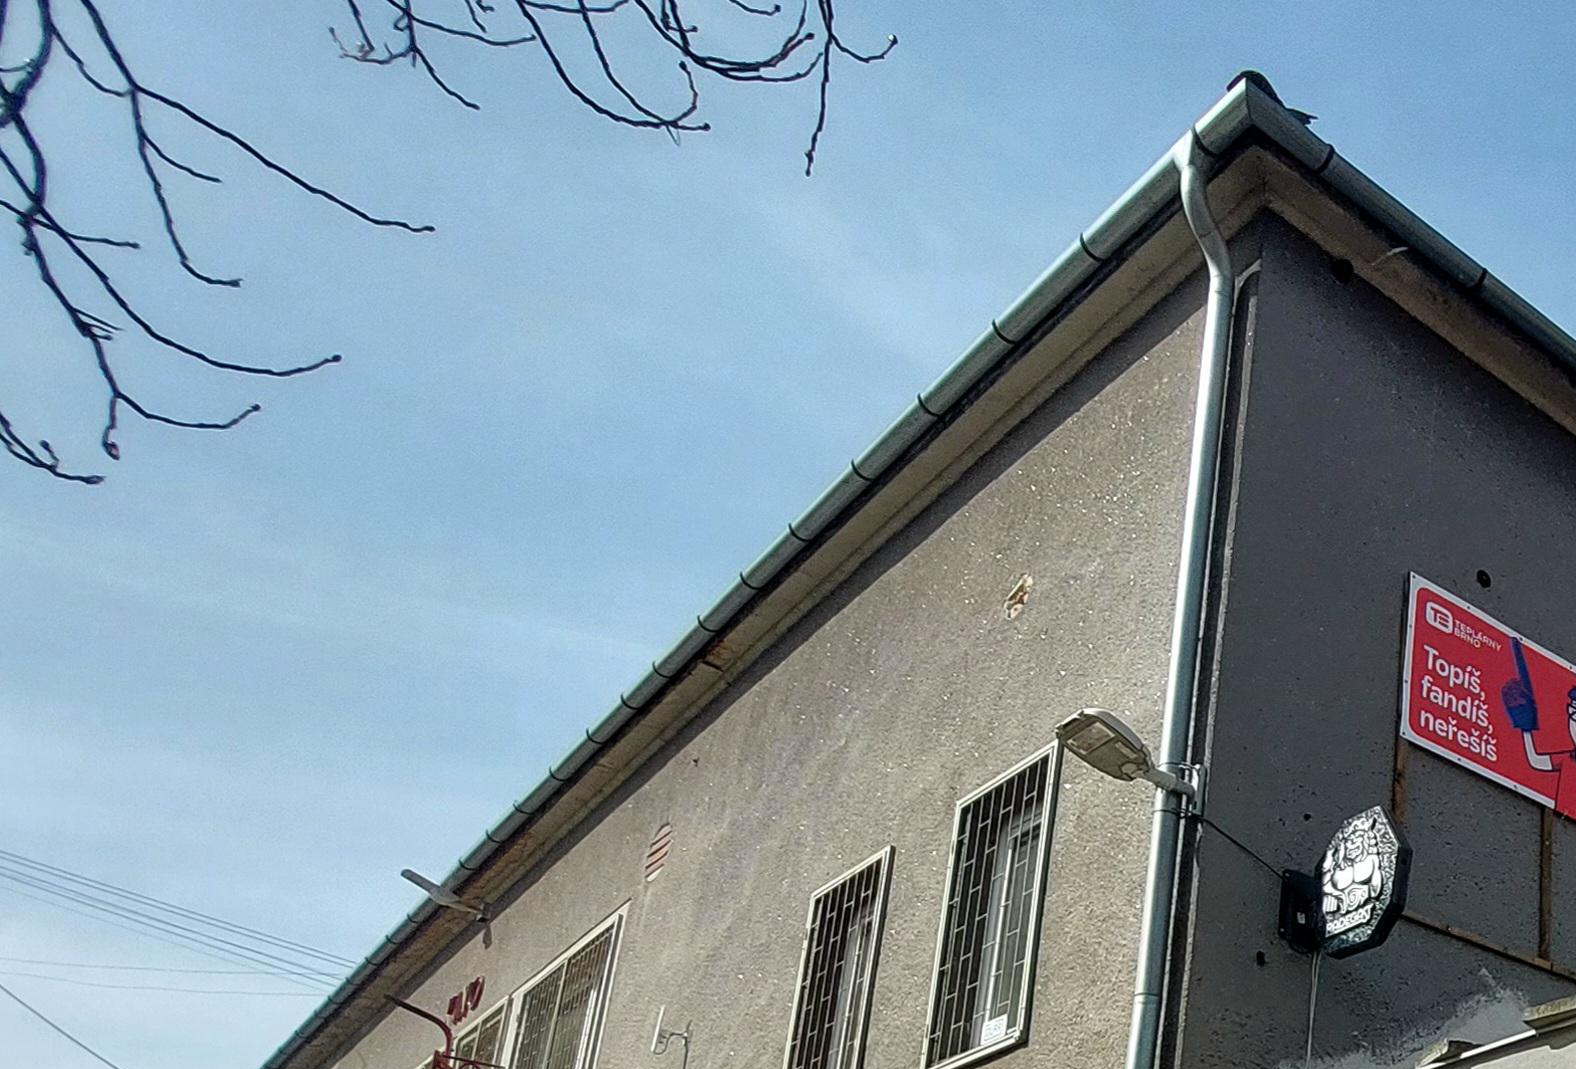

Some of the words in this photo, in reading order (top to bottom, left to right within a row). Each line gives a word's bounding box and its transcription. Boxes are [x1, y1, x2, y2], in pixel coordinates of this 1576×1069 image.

[1454, 619, 1502, 651] TEPLÁRNY
[1454, 627, 1481, 648] BRNO
[1423, 644, 1486, 701] Topíš,
[1421, 675, 1493, 734] fandíš,
[1419, 710, 1498, 762] neřešíš
